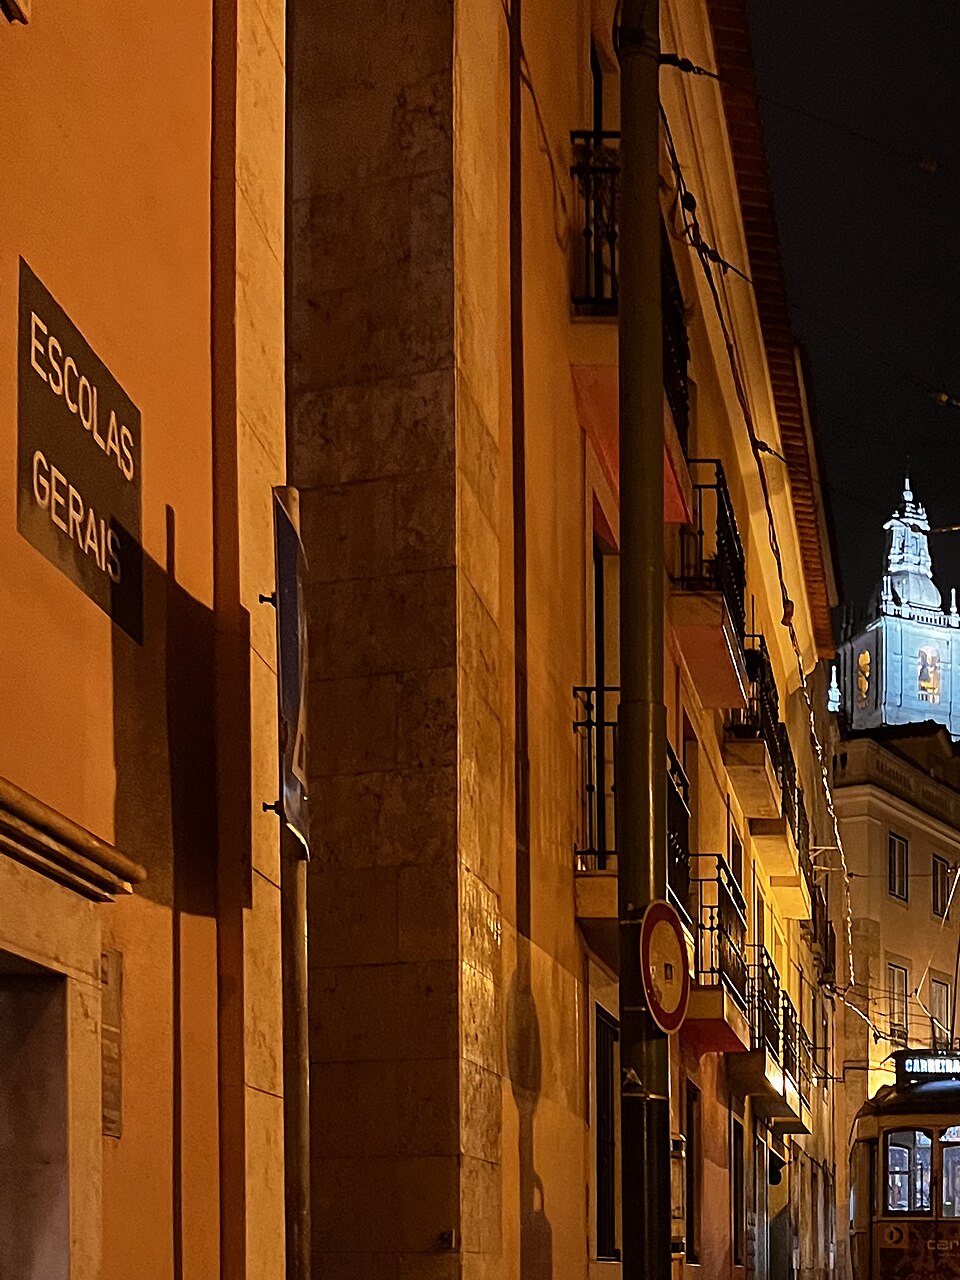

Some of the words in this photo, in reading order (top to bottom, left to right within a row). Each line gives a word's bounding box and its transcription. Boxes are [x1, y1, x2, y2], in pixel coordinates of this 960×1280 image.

[31, 311, 135, 482] ESCOLAS
[32, 449, 121, 584] GERAIS
[904, 1058, 960, 1074] CARREIRA
